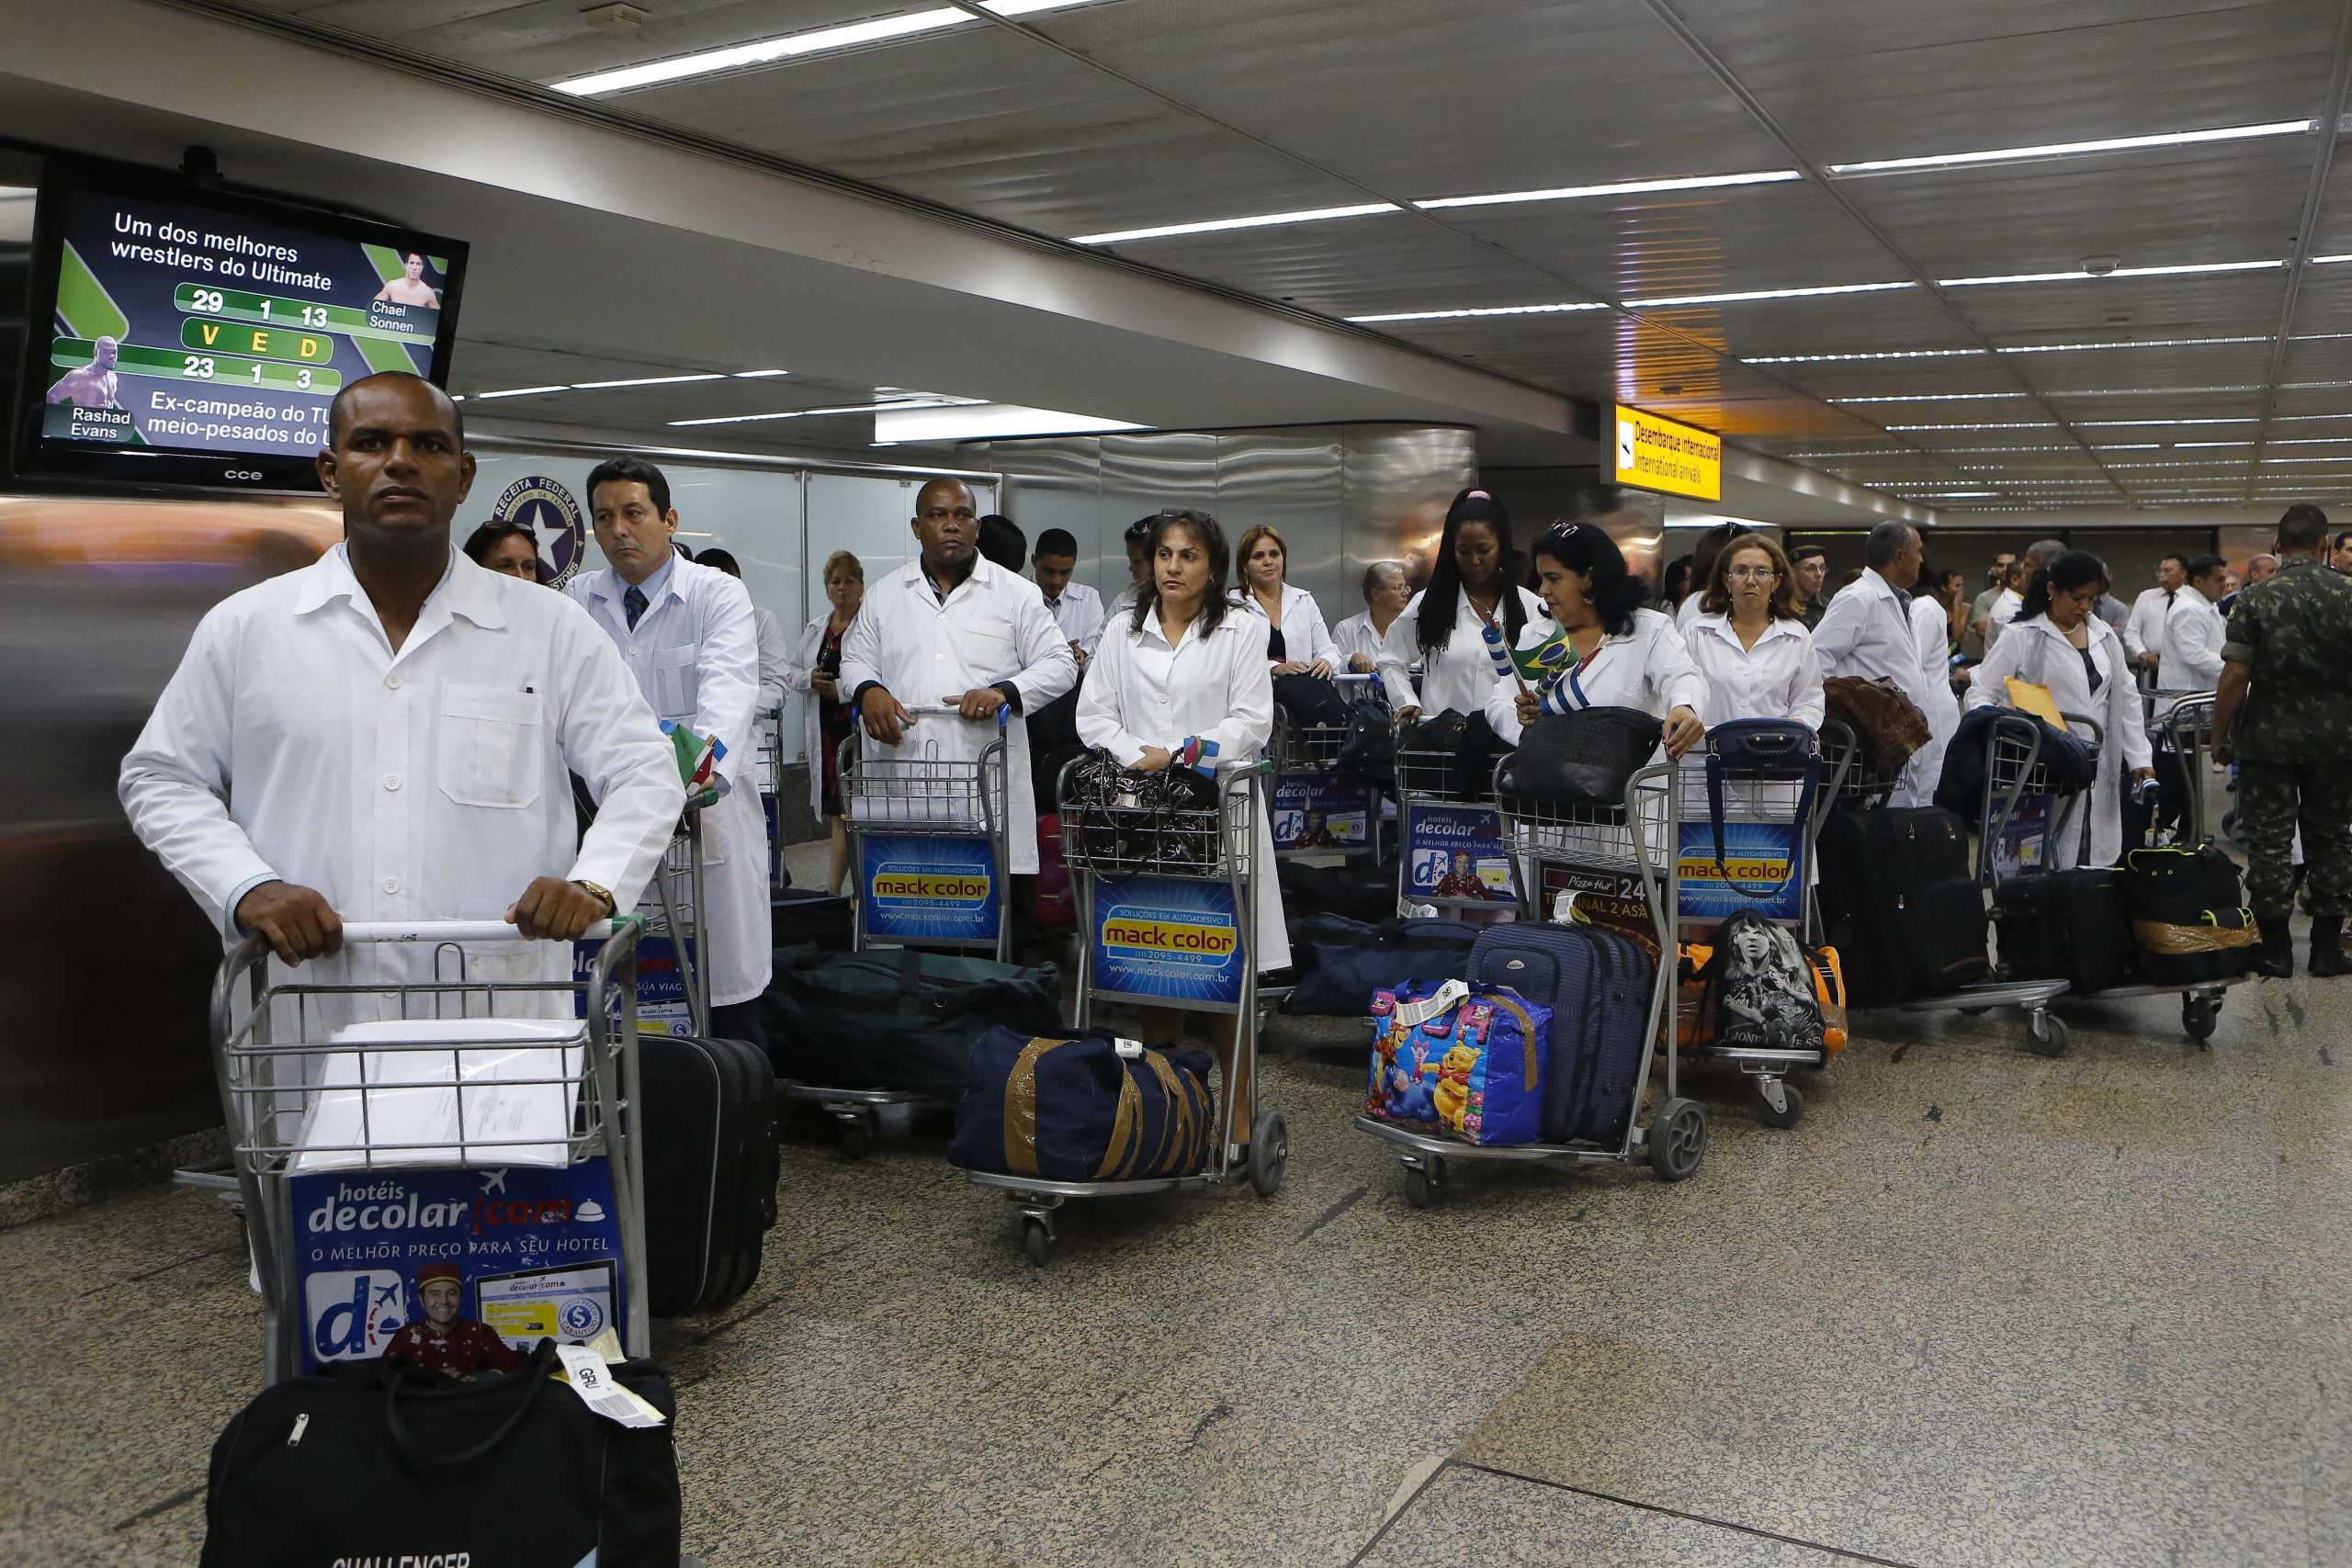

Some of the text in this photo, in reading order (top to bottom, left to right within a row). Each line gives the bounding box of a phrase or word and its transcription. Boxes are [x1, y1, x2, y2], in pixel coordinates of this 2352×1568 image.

[115, 211, 298, 263] Um dos melhores
[111, 241, 332, 290] wrestlers do Ultimate
[191, 289, 328, 328] 29 1 13
[371, 301, 406, 317] Chael
[369, 316, 414, 333] Sonnen
[202, 324, 317, 357] V E D
[183, 355, 312, 389] 23 1 3
[73, 407, 131, 424] Rashad
[151, 391, 277, 422] Ex-campeão
[281, 404, 305, 423] do
[71, 423, 118, 439] Evans
[148, 416, 288, 443] meio-pesados
[293, 425, 317, 446] do
[1635, 421, 1719, 462] Desembarque internacional
[1679, 461, 1702, 484] arrivals
[495, 479, 581, 519] RECEITA FEDERAL
[553, 561, 579, 590] STOMS
[1276, 784, 1325, 797] decolar
[1416, 818, 1476, 836] decolar
[1678, 863, 1787, 878] mack color
[876, 878, 986, 897] mack color
[1567, 875, 1613, 891] Pizza Hut
[1620, 878, 1646, 901] 24
[913, 899, 961, 908] 2095-4499
[1611, 902, 1618, 914] 2
[1679, 894, 1787, 905] www.mackcolor.com.br
[880, 911, 985, 923] www.mackcolor.com.br
[1120, 908, 1158, 919] SOLUÇÕES
[1172, 913, 1223, 925] AUTOADESIVO
[1106, 926, 1233, 952] mack color
[1148, 951, 1202, 964] 2095-4499
[1110, 964, 1229, 983] www.mackcolor.com.br
[637, 982, 655, 991] SUA
[339, 1180, 404, 1202] hotéis
[309, 1193, 469, 1233] decolar
[311, 1248, 323, 1262] O
[409, 1243, 461, 1259] PREÇO
[469, 1241, 513, 1255] PARA
[520, 1239, 549, 1253] SEU
[557, 1237, 609, 1252] HOTEL
[579, 1368, 600, 1390] GRU
